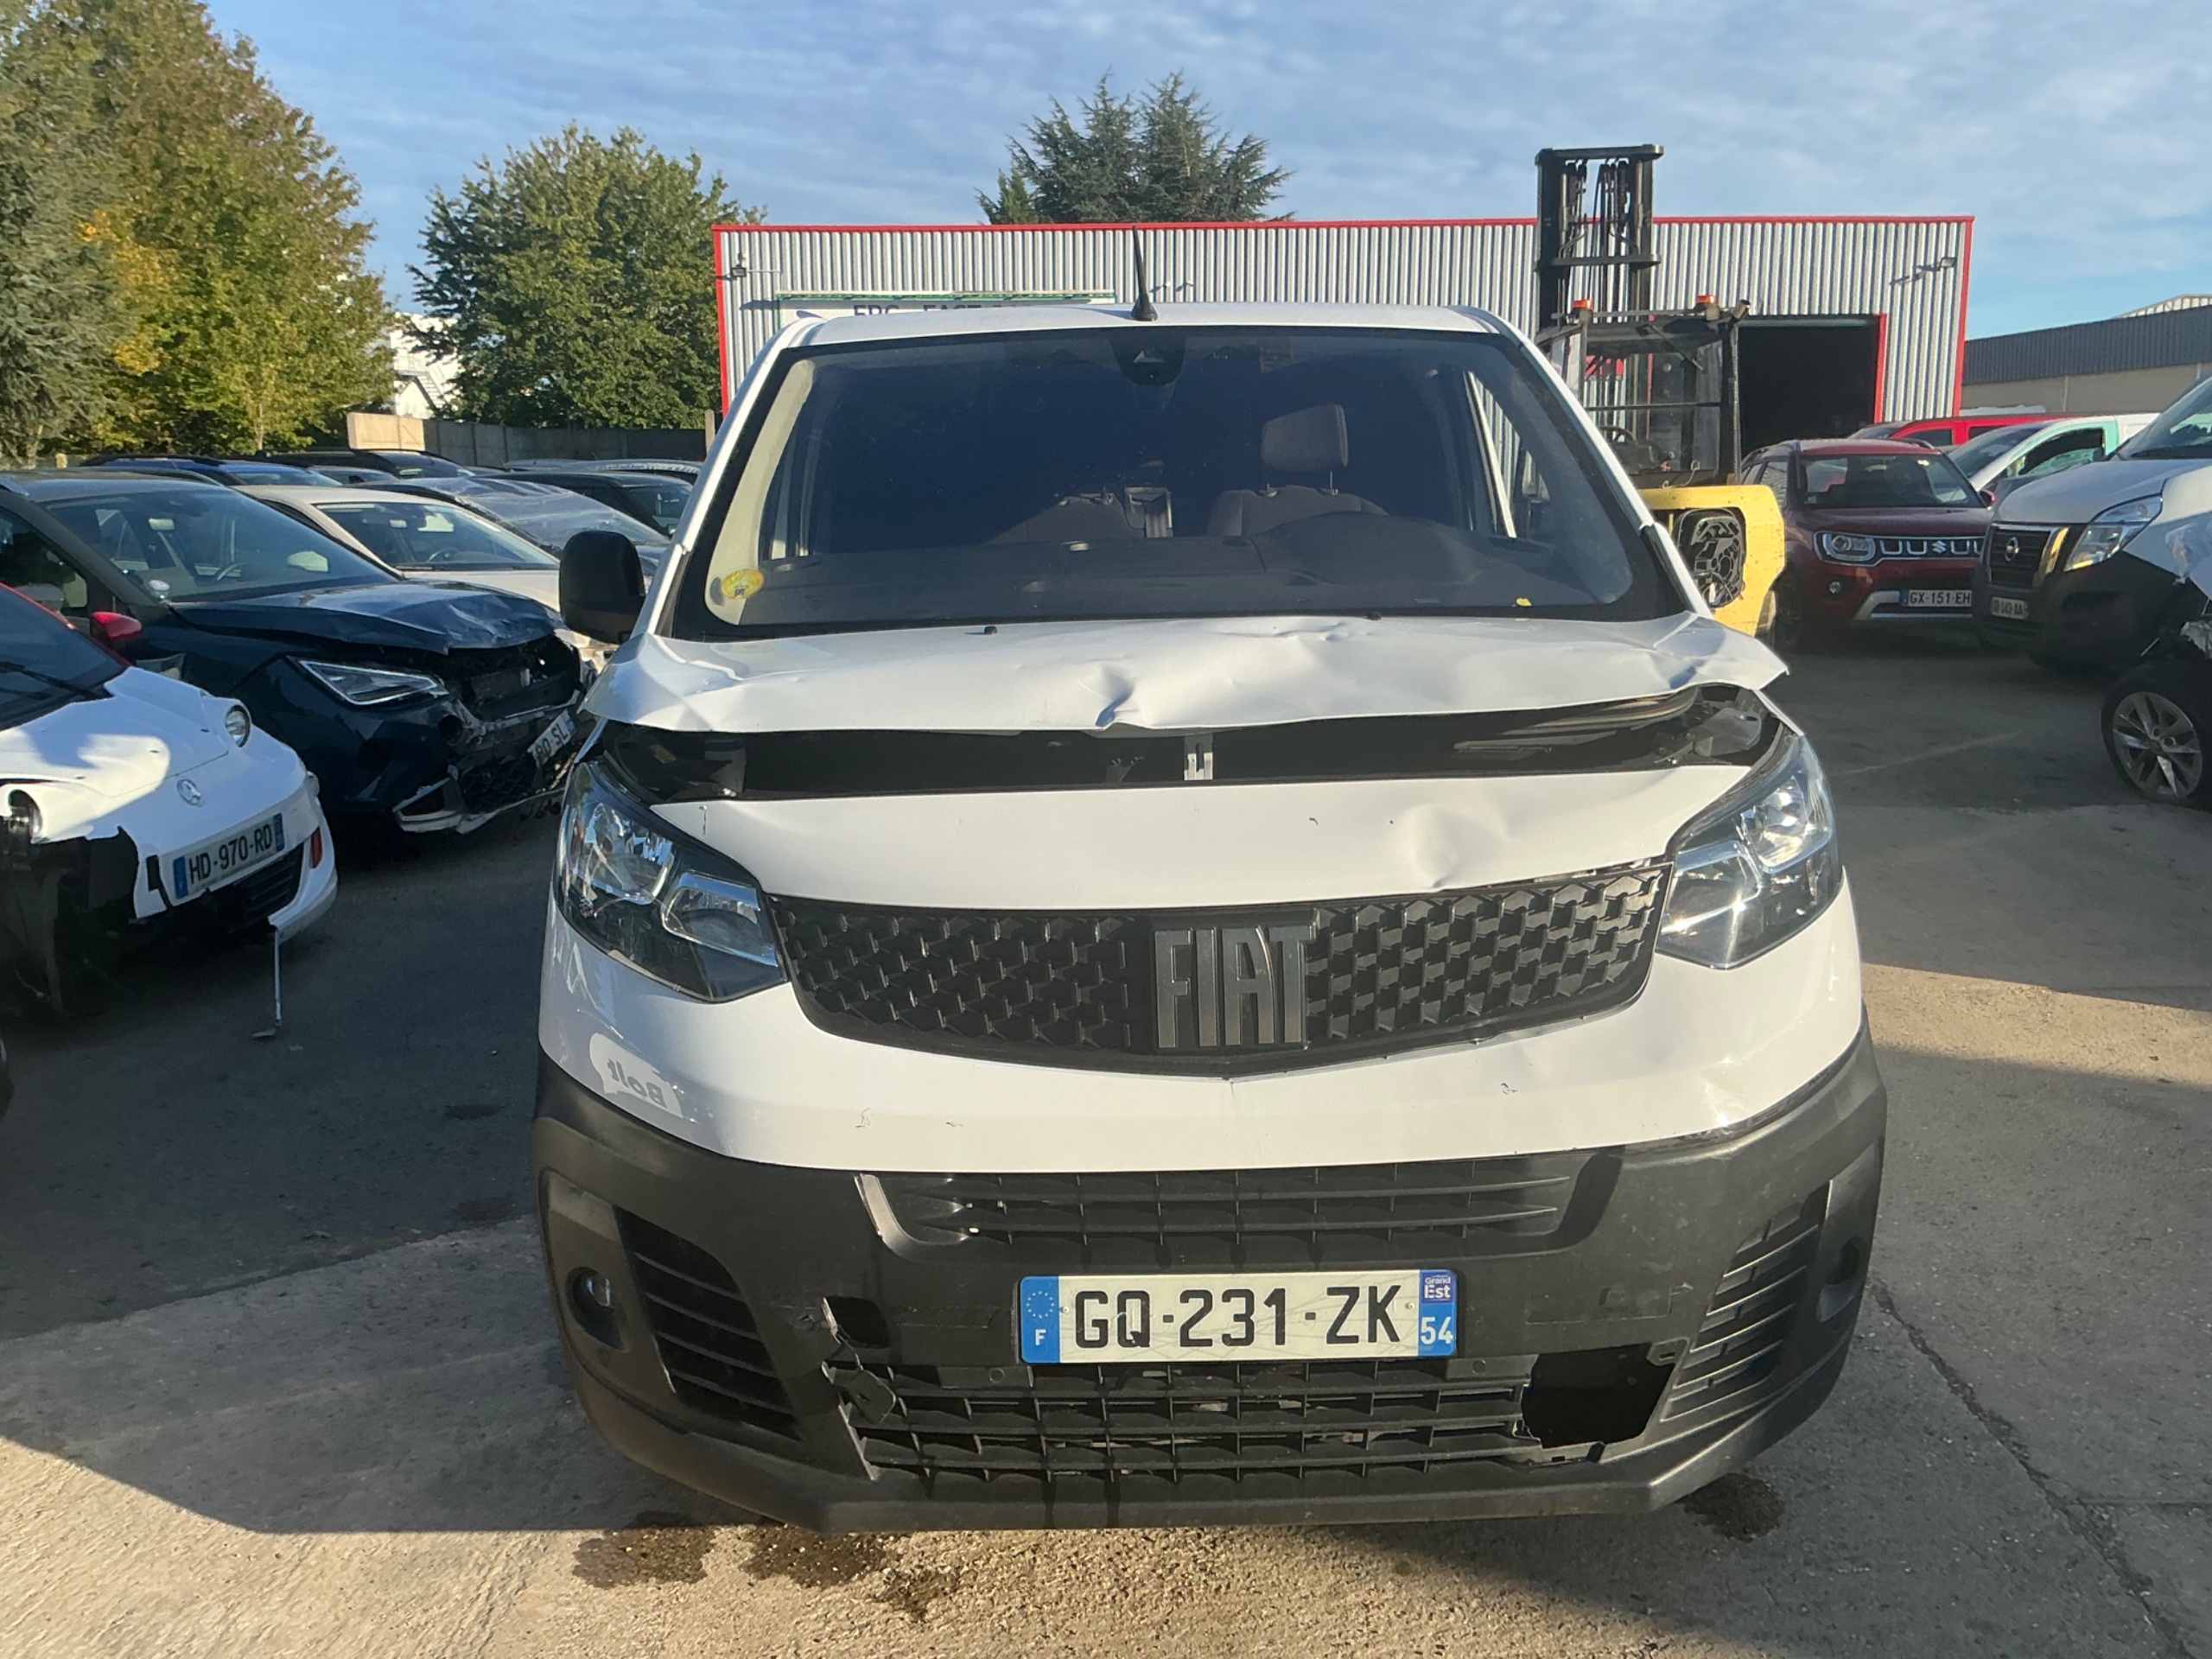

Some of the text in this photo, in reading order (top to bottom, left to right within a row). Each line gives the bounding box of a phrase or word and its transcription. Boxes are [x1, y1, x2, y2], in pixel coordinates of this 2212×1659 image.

[1910, 592, 1971, 604] GX-151-EH
[1155, 925, 1312, 1049] FIAT
[1424, 1284, 1452, 1299] Est
[1075, 1285, 1402, 1349] GQ-231-ZK
[1035, 1329, 1046, 1346] F
[1421, 1316, 1453, 1344] 54
